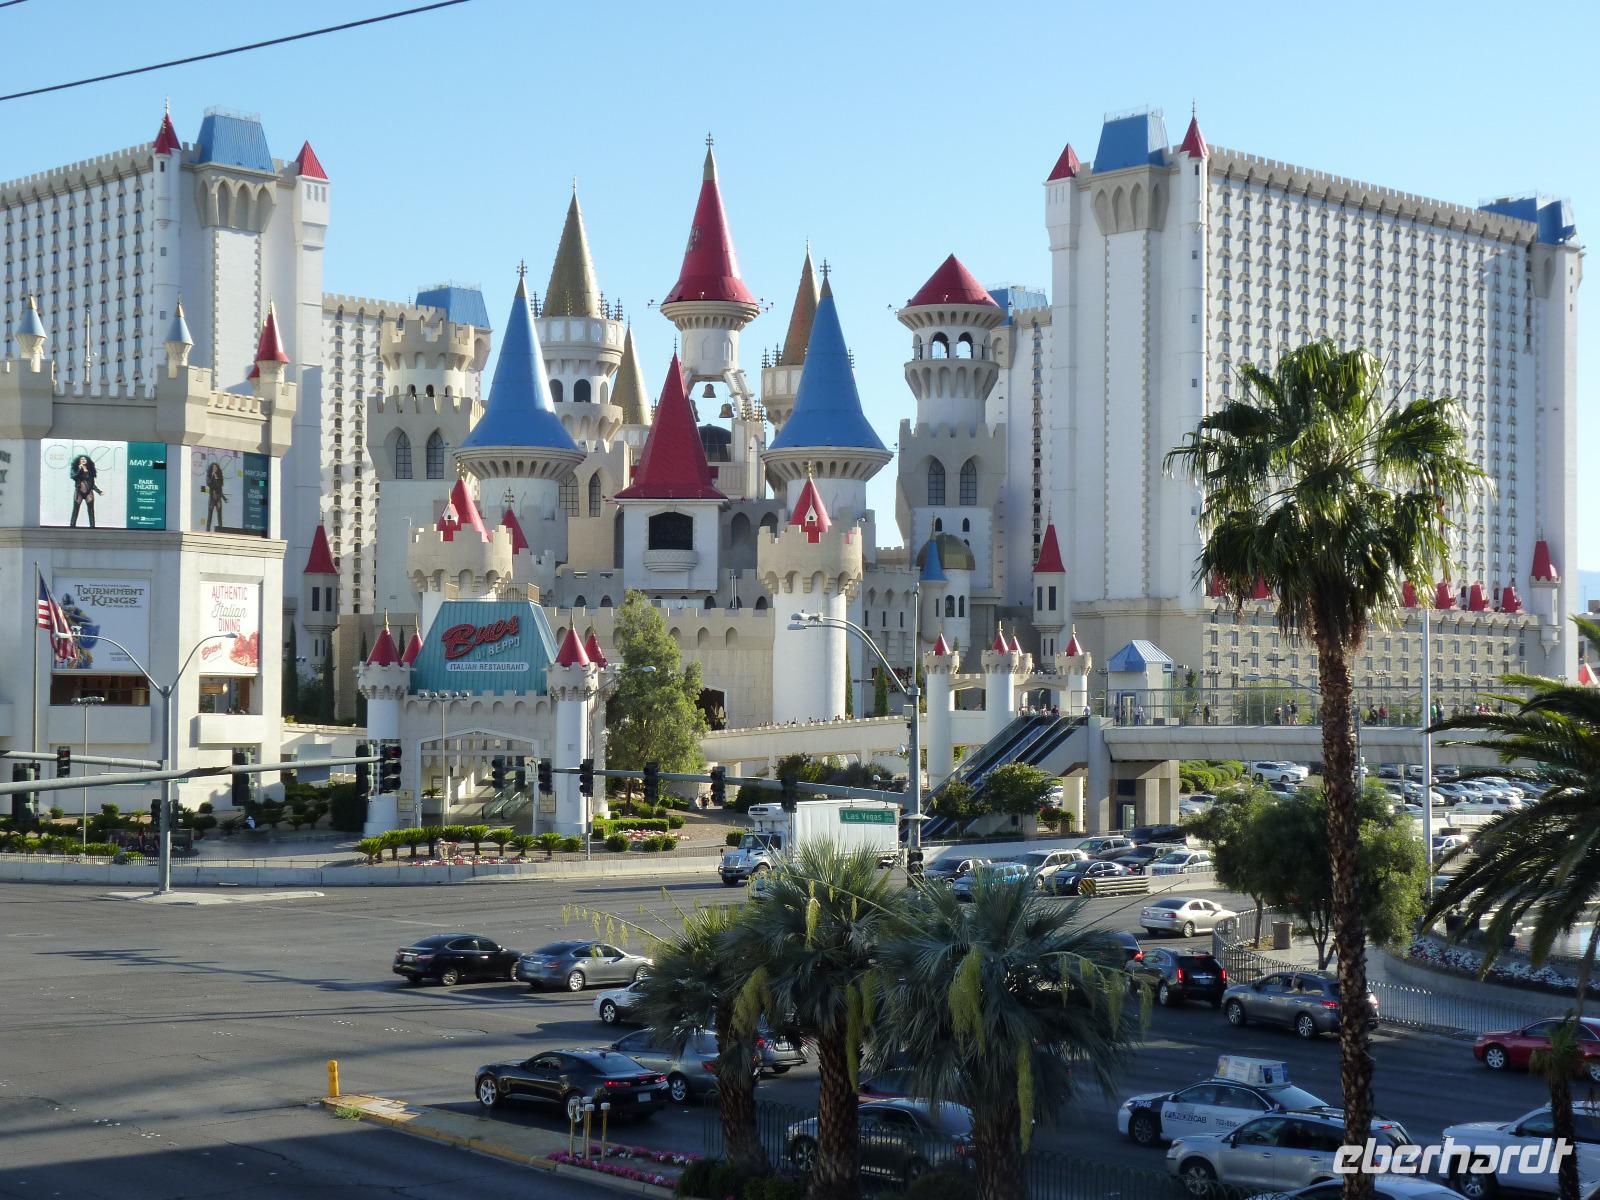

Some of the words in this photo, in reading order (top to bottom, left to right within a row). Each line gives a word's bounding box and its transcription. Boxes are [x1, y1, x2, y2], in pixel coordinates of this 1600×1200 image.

[129, 459, 148, 467] MAY
[74, 584, 145, 596] TOURNAMENT
[211, 585, 248, 601] AUTHENTIC
[91, 595, 138, 607] KINGS
[211, 602, 248, 618] Italian
[218, 618, 241, 632] DINING
[488, 637, 520, 655] BEPPO
[450, 663, 478, 671] ITALIAN
[479, 663, 525, 671] RESTAURANT
[845, 812, 859, 820] Las
[861, 812, 882, 822] Vegas
